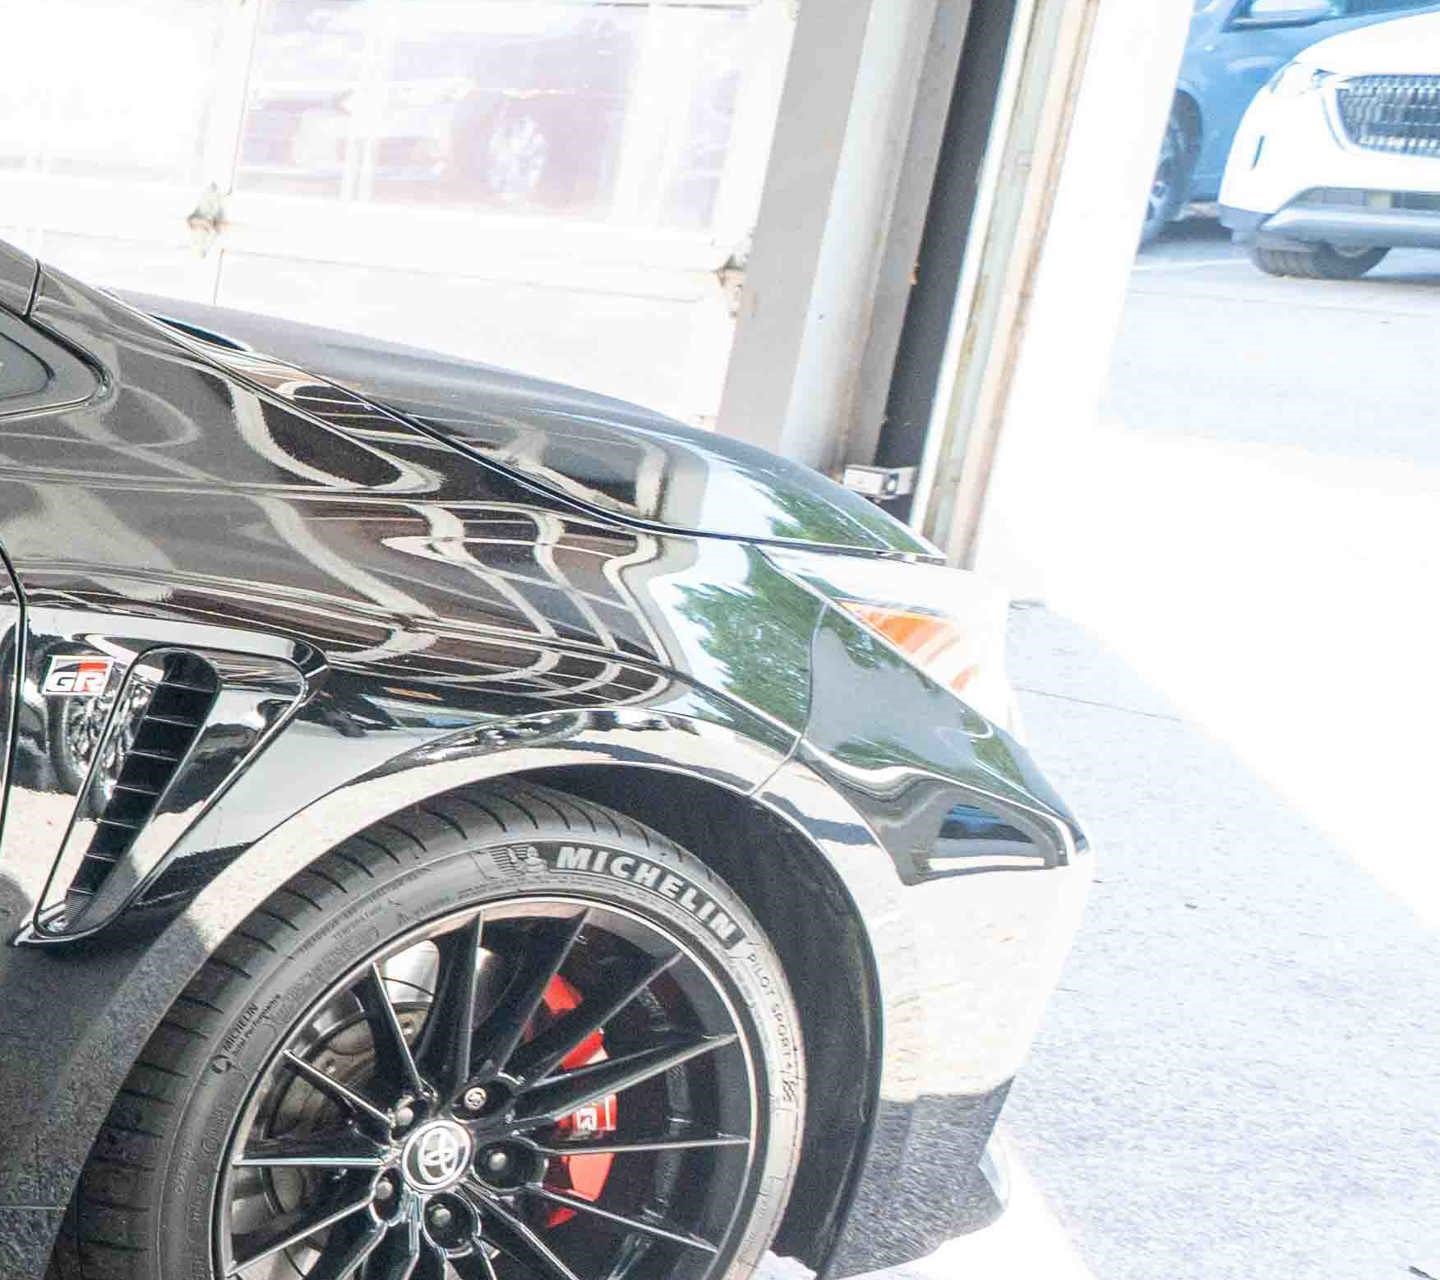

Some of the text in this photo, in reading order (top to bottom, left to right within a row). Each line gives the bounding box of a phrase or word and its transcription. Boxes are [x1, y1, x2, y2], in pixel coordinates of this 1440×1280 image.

[45, 668, 108, 694] GR
[556, 845, 738, 942] MICHELIN
[224, 1001, 258, 1052] MICHELIN
[747, 952, 776, 996] PILOT
[771, 1002, 792, 1056] SPORT
